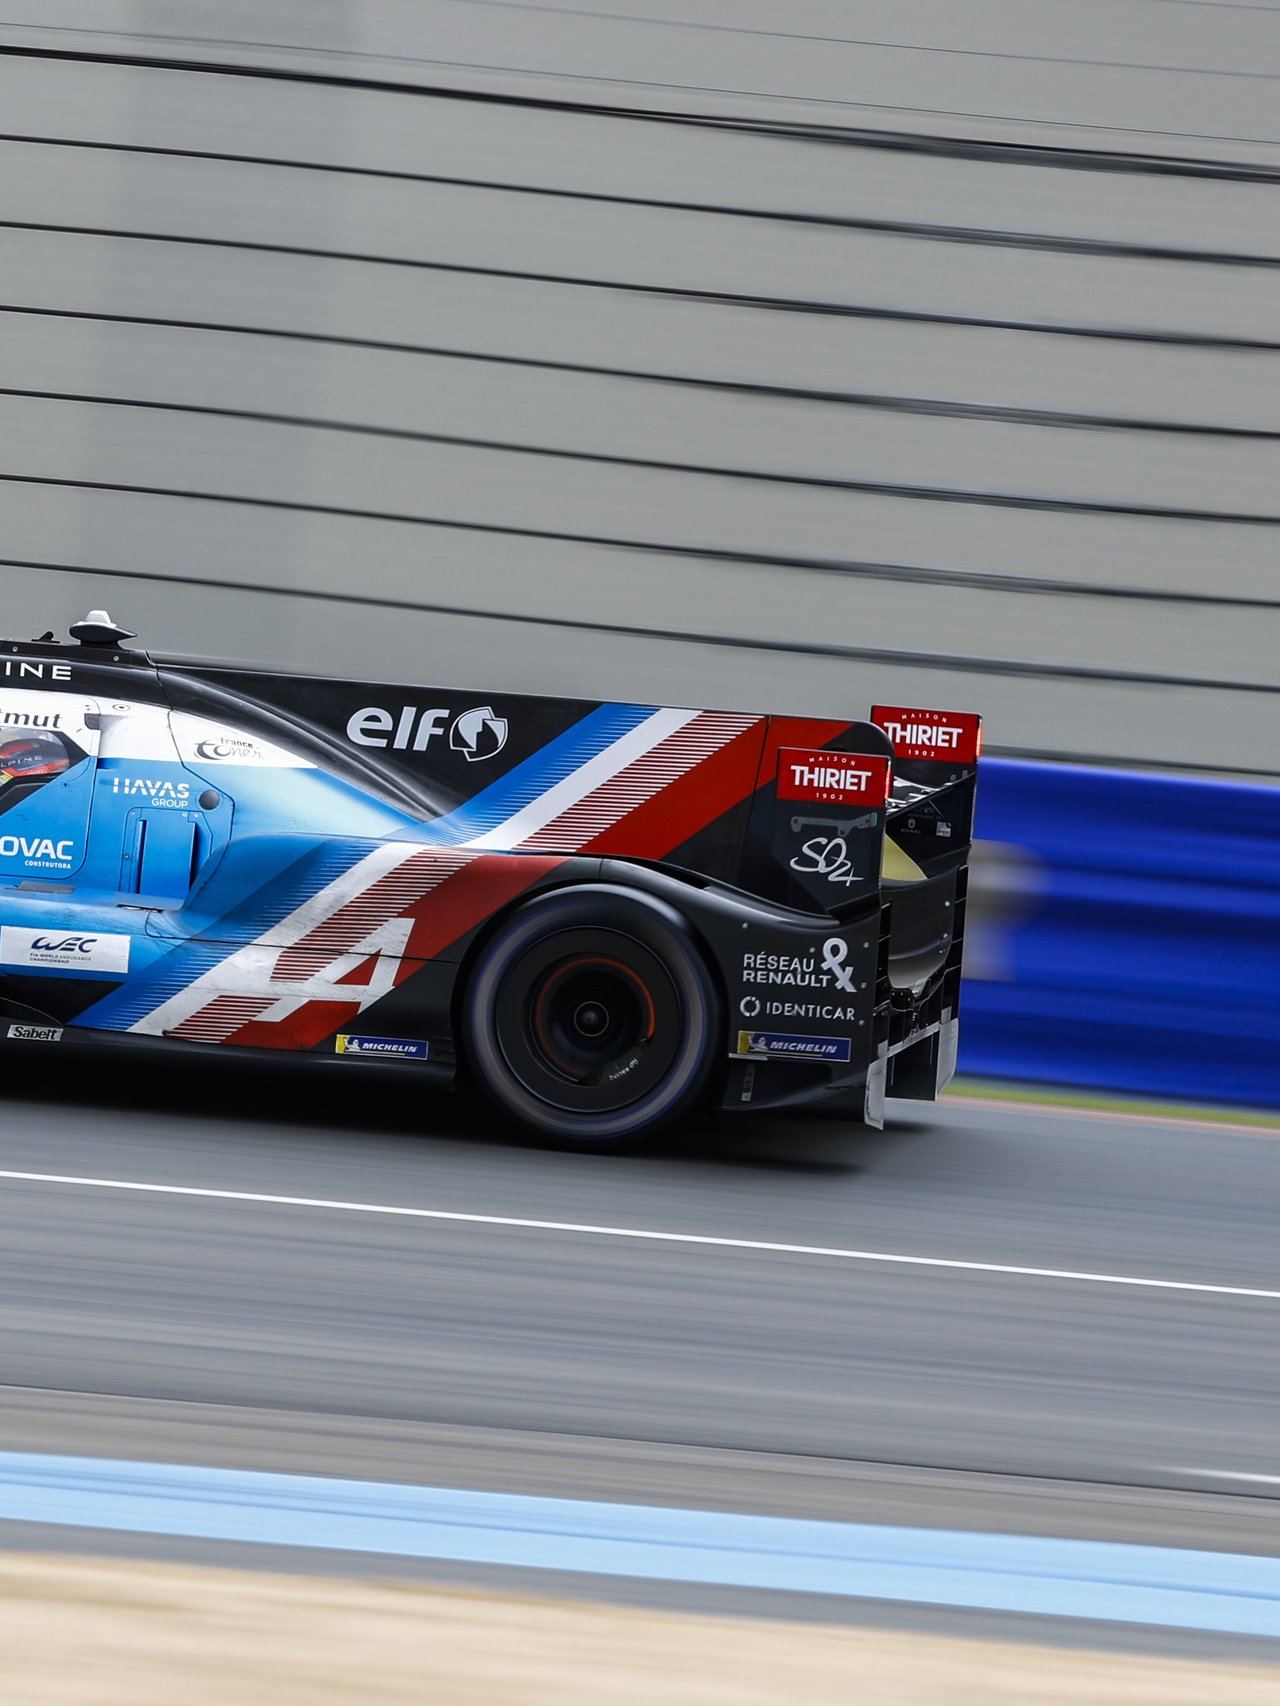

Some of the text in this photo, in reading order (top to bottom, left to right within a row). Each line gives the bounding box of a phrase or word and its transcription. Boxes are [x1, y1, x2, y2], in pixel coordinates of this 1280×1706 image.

[901, 713, 948, 723] MAISON
[346, 706, 451, 752] elf
[883, 722, 963, 748] THIRIET
[908, 749, 936, 757] 1902
[809, 756, 856, 767] MAISON
[790, 765, 872, 792] THIRIET
[113, 777, 190, 799] HAVAS
[151, 798, 188, 809] GROUP
[816, 792, 844, 801] 1902
[24, 860, 72, 869] CONSTRUTORA
[31, 936, 98, 953] WEC
[743, 951, 815, 972] RÉSEAU
[742, 970, 832, 988] RENAULT
[766, 1002, 855, 1021] IDENTICAR
[13, 1026, 57, 1040] Sabelt
[362, 1042, 417, 1053] MICHELIN
[770, 1041, 838, 1054] MICHELIN
